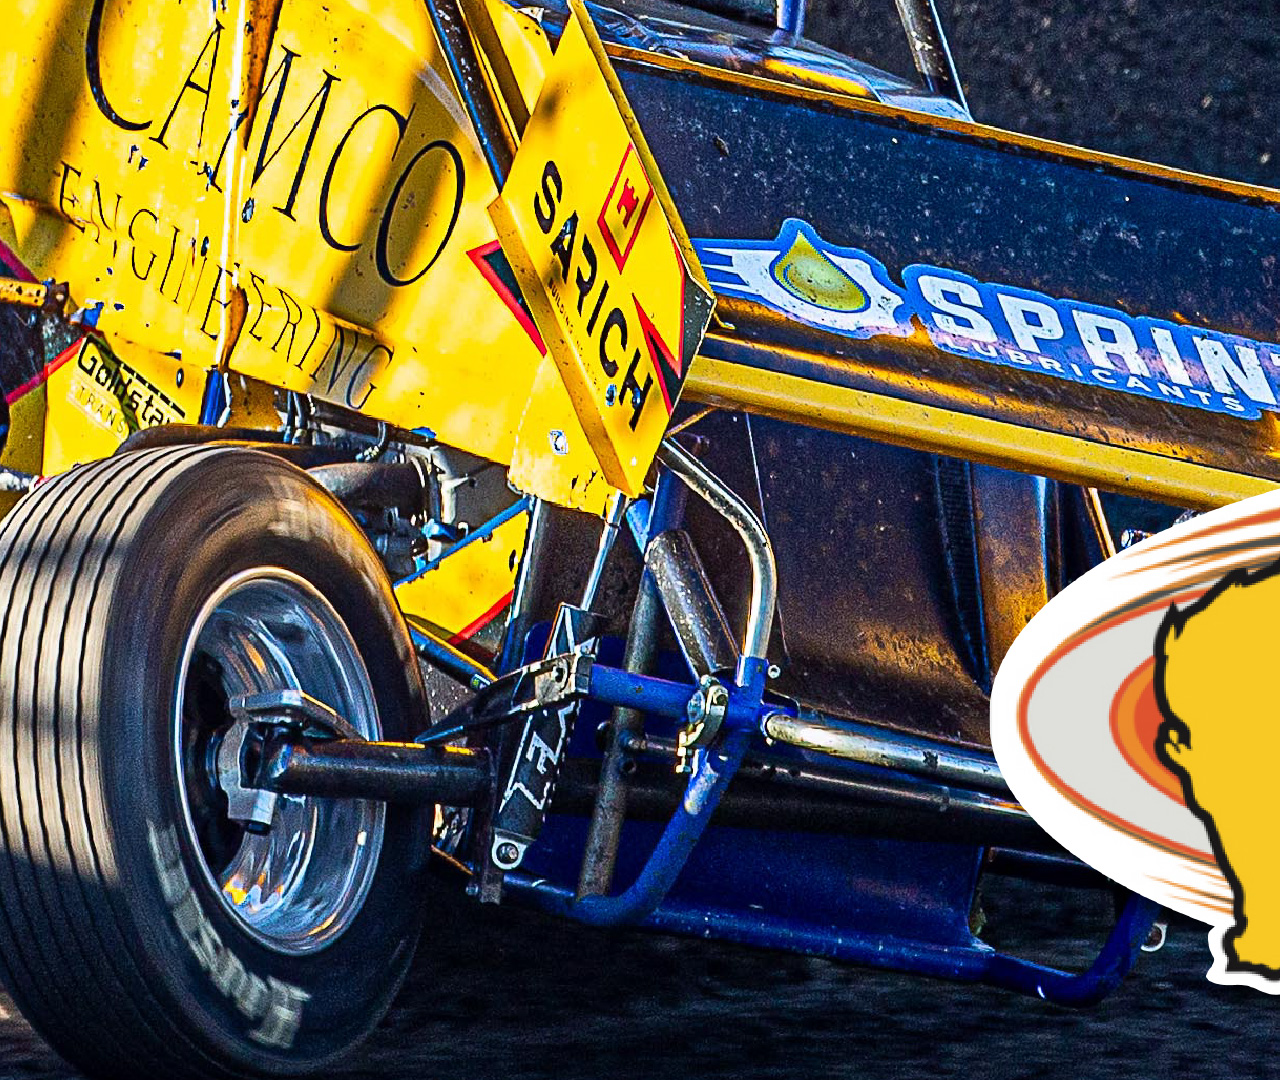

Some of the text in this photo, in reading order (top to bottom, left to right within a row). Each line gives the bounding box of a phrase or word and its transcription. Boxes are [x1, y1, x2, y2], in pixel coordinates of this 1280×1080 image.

[58, 161, 396, 411] ENGINEERING
[533, 159, 654, 432] SARICH
[943, 336, 1246, 413] LUBRICANTS
